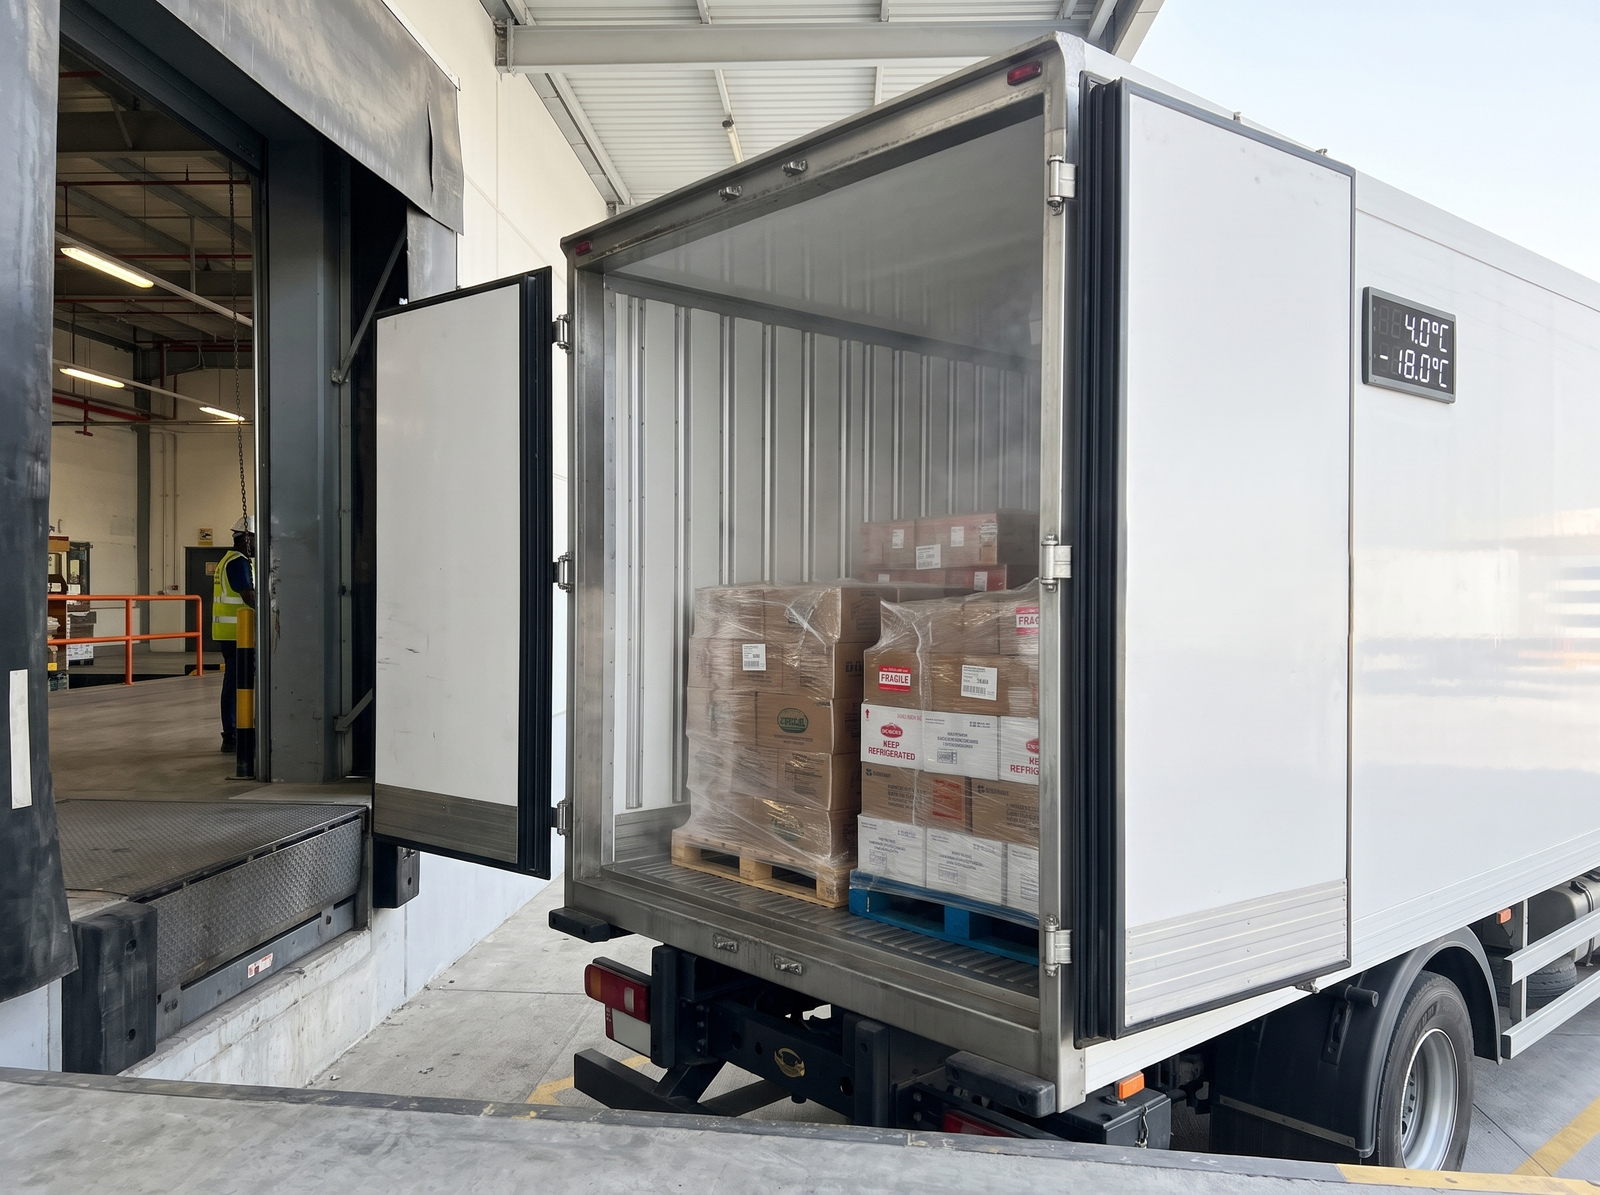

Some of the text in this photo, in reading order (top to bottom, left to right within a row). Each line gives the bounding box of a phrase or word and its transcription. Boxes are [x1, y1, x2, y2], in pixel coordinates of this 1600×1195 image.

[1404, 313, 1449, 353] 4.0°C
[881, 673, 909, 684] FRAGILE
[883, 740, 900, 749] KEEP
[868, 746, 916, 761] REFRIGERATED
